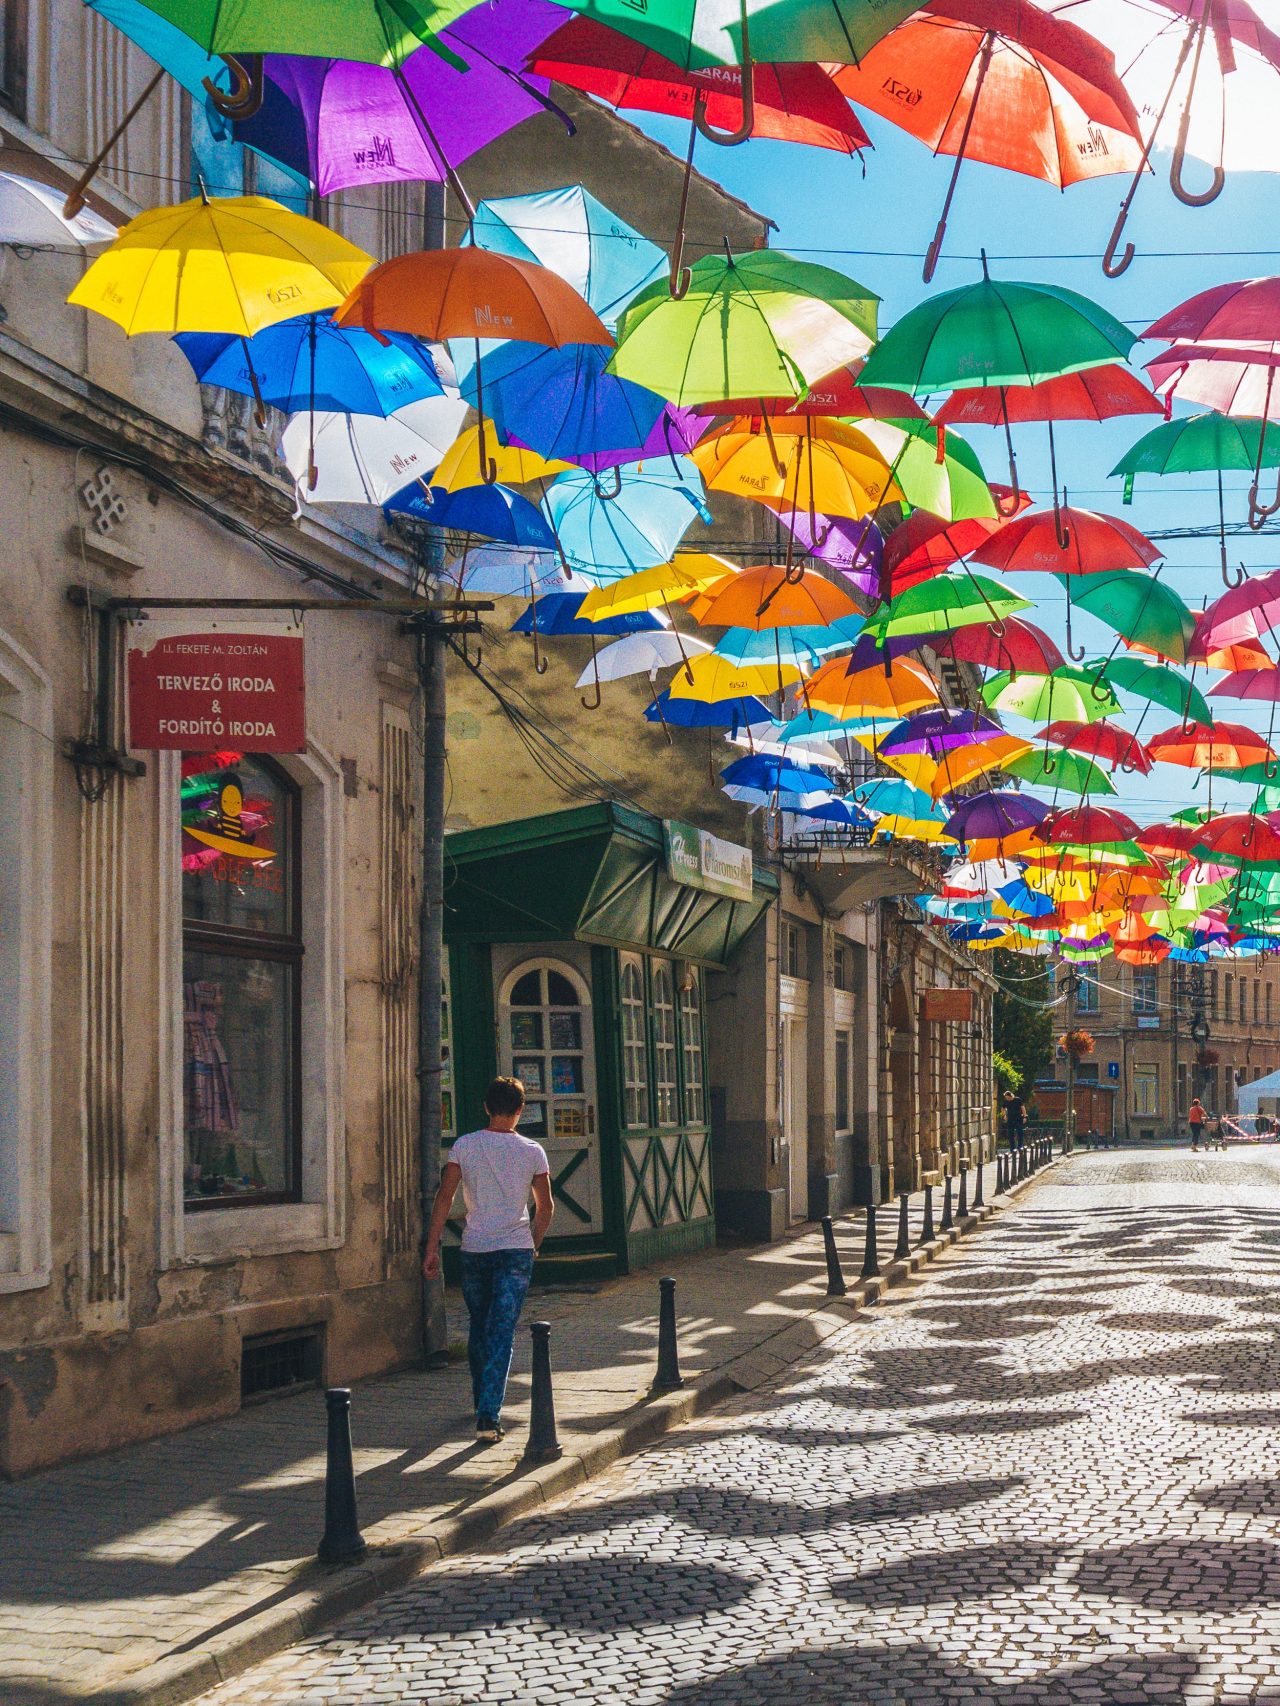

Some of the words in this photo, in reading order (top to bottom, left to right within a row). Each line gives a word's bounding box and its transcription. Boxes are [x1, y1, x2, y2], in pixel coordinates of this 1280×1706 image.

[690, 65, 742, 84] ARAH
[473, 304, 513, 327] NEW
[390, 453, 418, 475] NEW
[176, 644, 210, 654] FEKETE
[212, 645, 225, 655] M.
[227, 643, 268, 655] ZOLTÁN
[157, 673, 223, 691] TERVEZŐ
[228, 677, 275, 692] IRODA
[211, 700, 222, 714] &
[159, 716, 224, 736] FORDÍTÓ
[229, 721, 276, 737] IRODA
[891, 756, 908, 772] ZARAH
